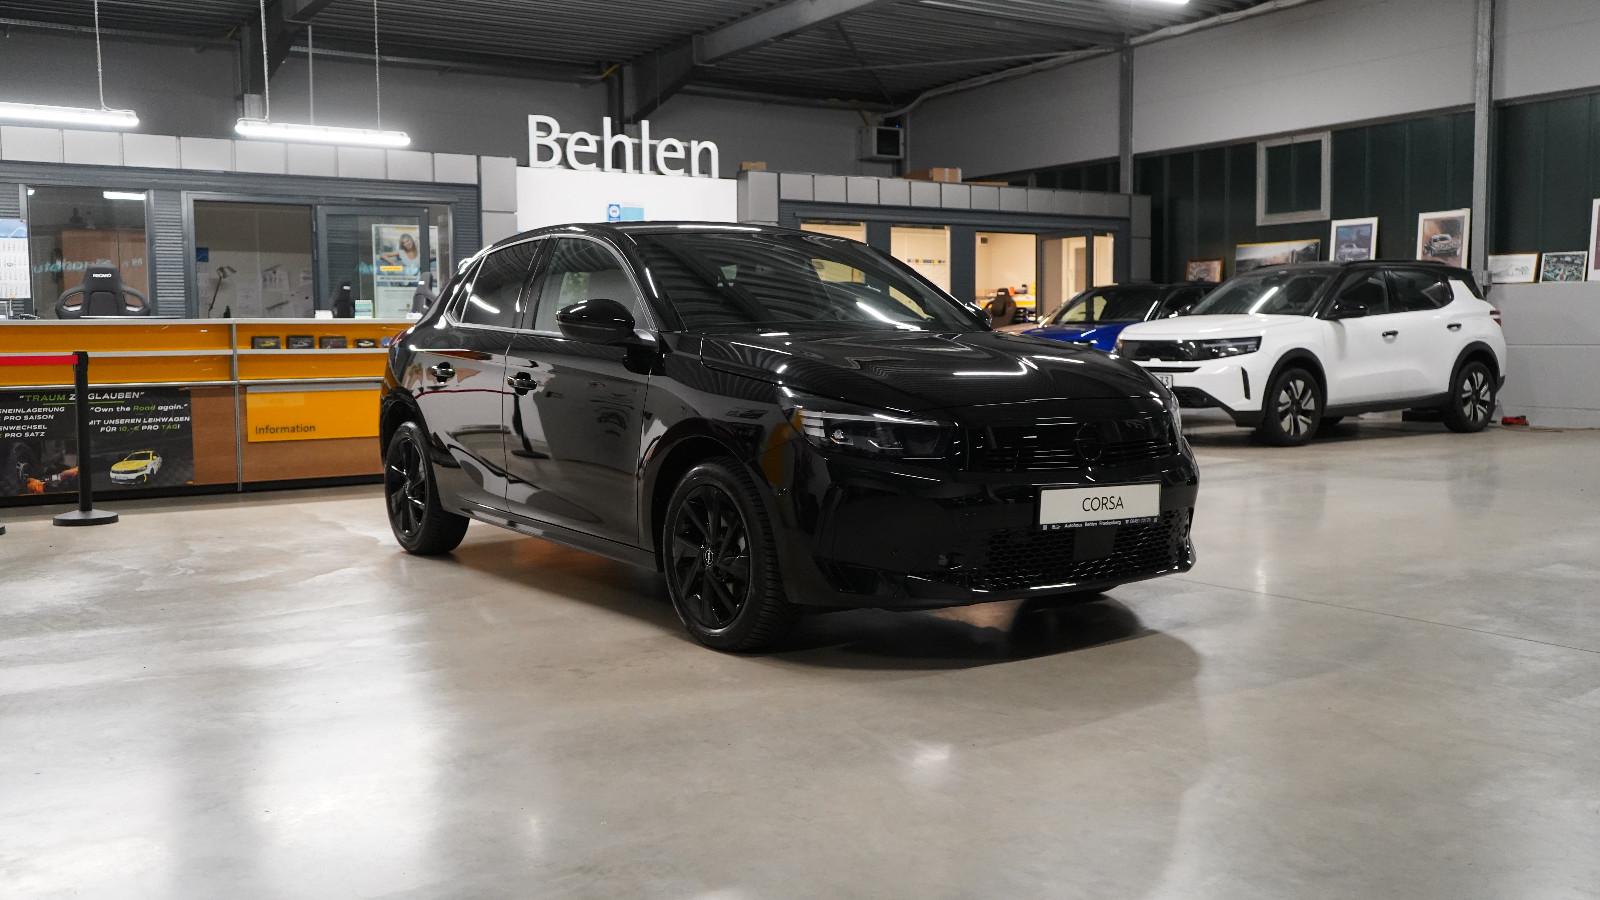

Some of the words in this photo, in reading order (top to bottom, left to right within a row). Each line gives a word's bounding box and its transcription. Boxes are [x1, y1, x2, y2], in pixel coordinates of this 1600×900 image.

[528, 114, 720, 179] Behlen
[256, 424, 316, 434] Information
[1082, 496, 1124, 512] CORSA
